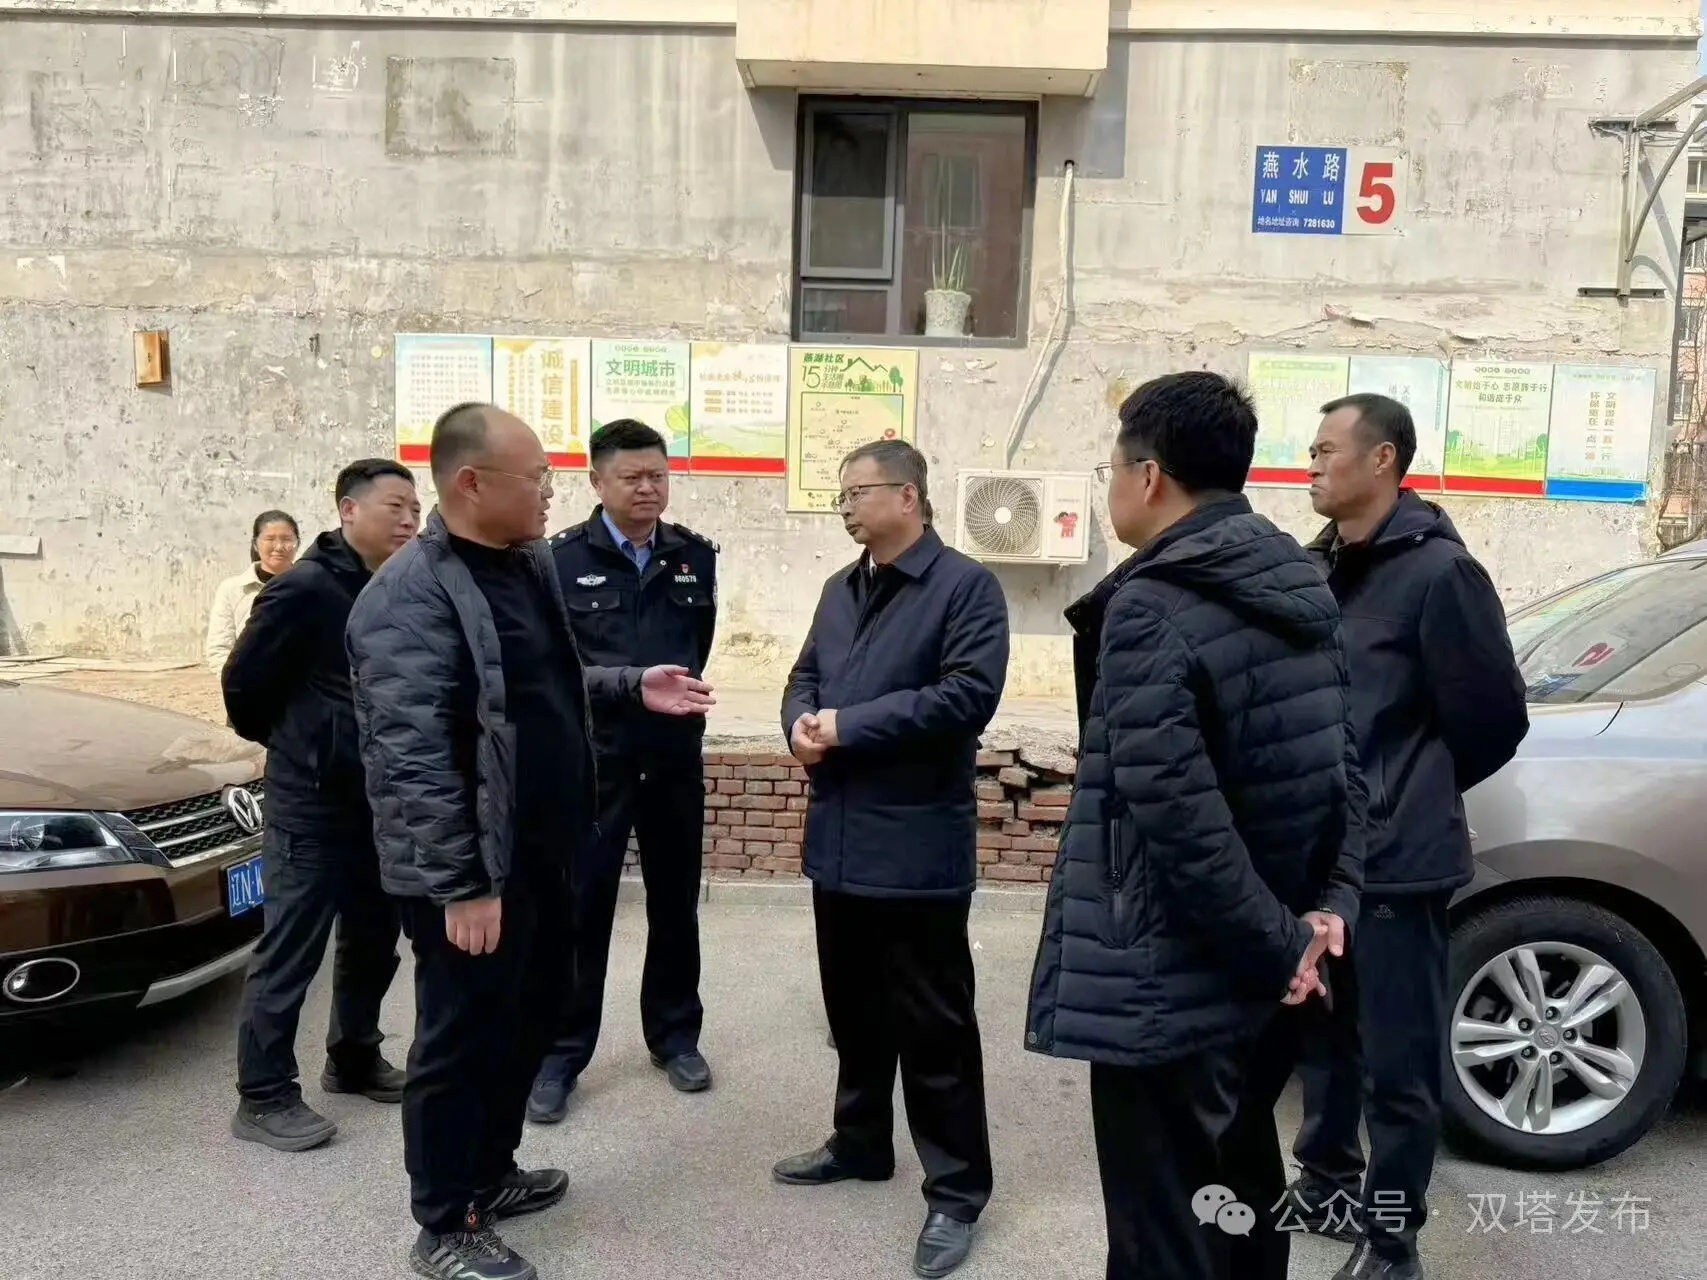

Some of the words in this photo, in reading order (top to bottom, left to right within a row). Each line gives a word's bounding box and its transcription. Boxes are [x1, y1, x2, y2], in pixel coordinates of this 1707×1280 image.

[1262, 151, 1340, 182] 燕水路
[1260, 188, 1278, 204] YAN
[1288, 189, 1309, 205] SHUI
[1323, 190, 1334, 205] LU
[1356, 162, 1395, 224] 5
[1303, 218, 1335, 229] 7281630
[606, 358, 676, 377] 文明城市
[802, 365, 821, 388] 15
[541, 347, 564, 445] 诚信建设
